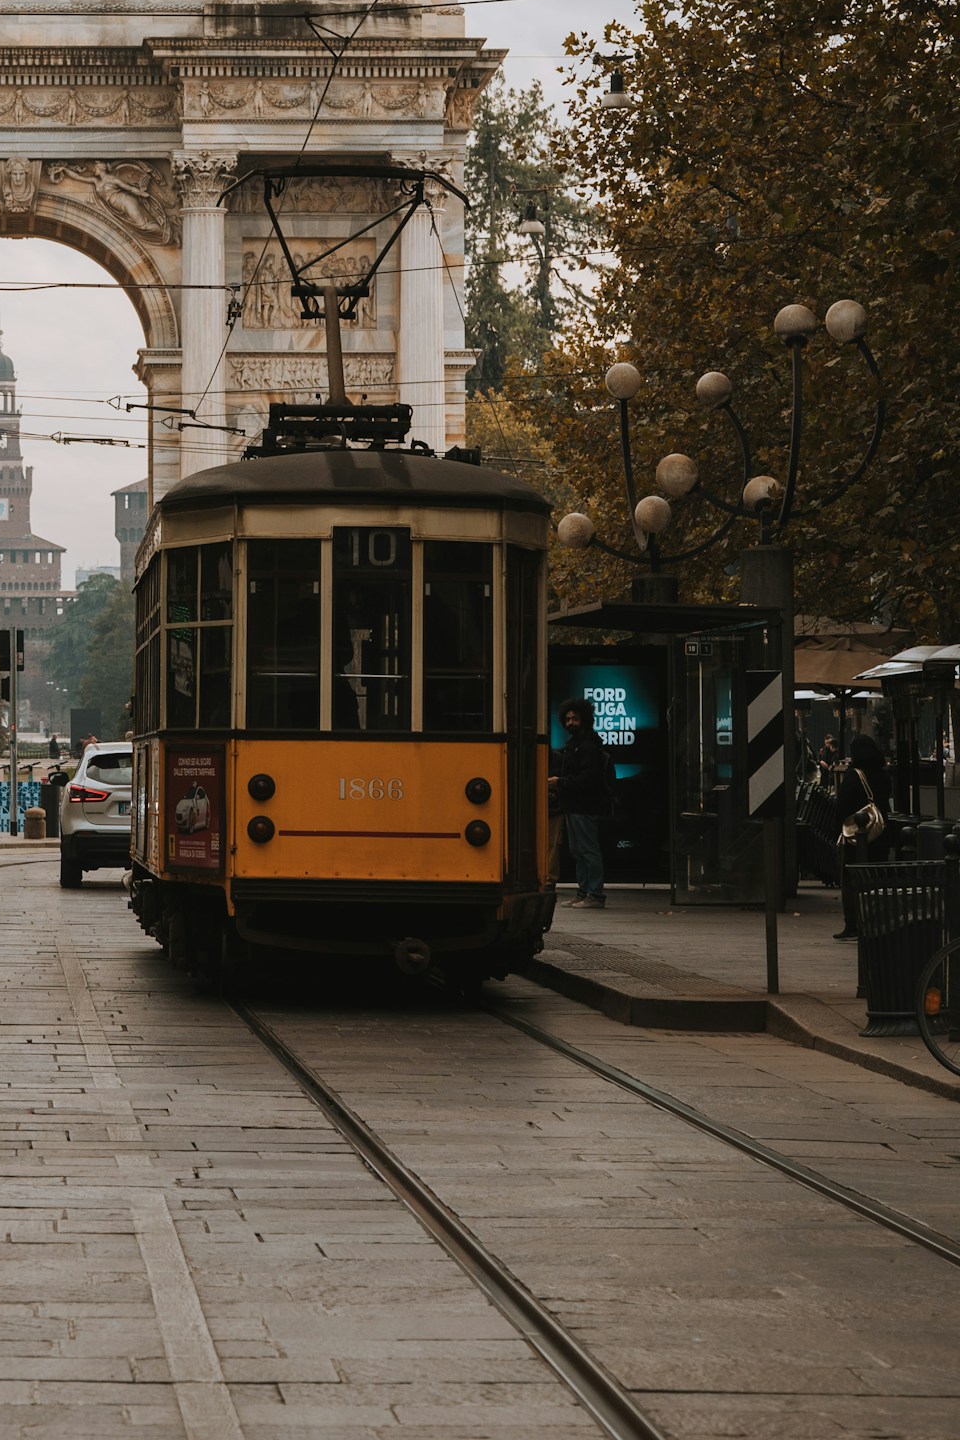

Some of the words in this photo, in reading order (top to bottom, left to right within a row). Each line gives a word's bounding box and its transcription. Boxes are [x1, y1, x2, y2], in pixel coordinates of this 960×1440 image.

[351, 530, 396, 567] 10
[583, 687, 626, 702] FORD
[592, 702, 627, 716] UGA
[592, 716, 636, 731] UG-IN
[597, 731, 635, 746] BRID
[339, 778, 404, 800] 1866
